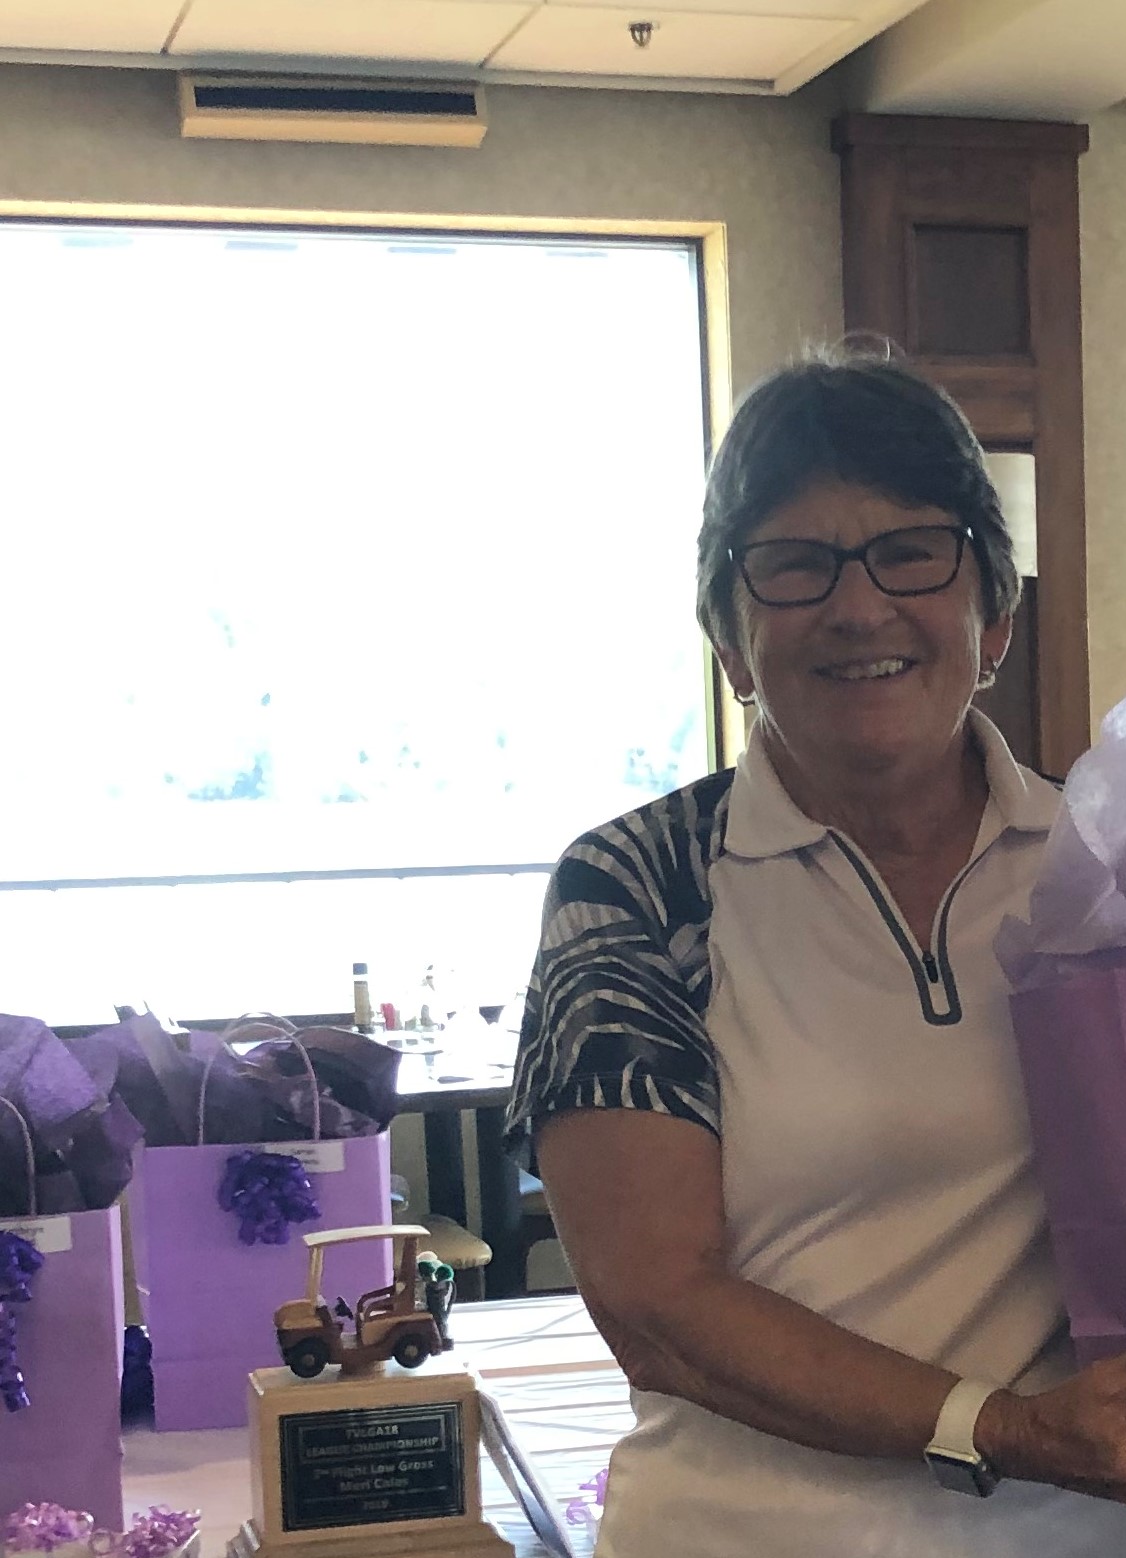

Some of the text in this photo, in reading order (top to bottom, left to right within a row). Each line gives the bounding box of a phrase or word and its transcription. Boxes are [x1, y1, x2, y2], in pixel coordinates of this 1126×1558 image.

[352, 1436, 439, 1455] CHAMPIONSHIP
[370, 1462, 395, 1474] Low
[399, 1460, 434, 1472] Gross
